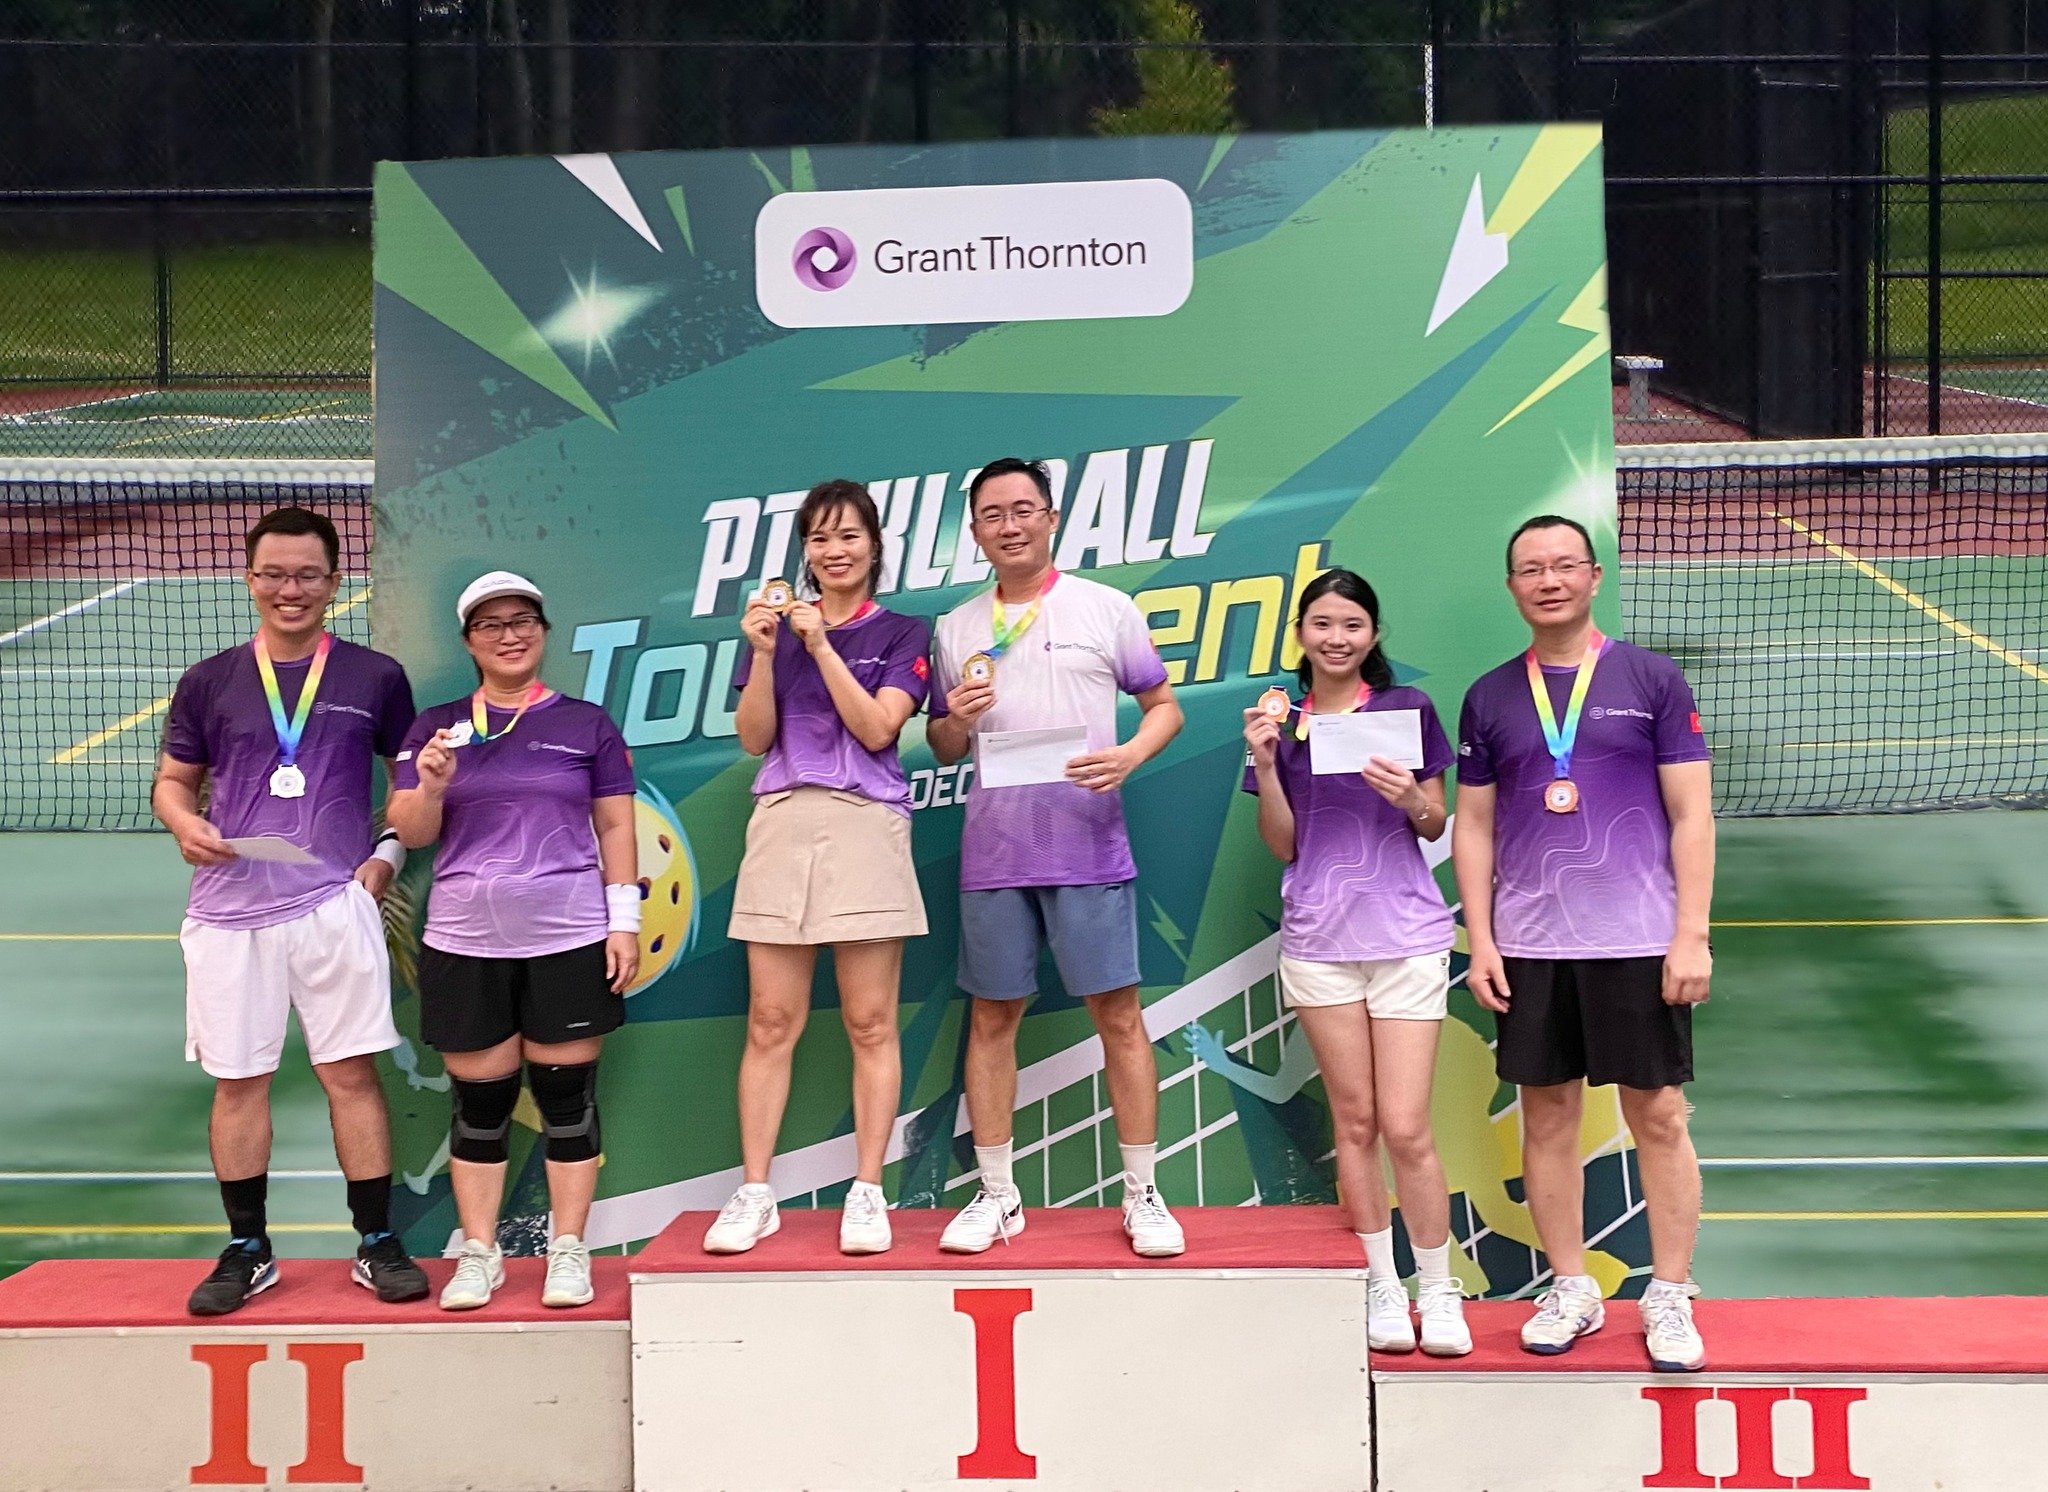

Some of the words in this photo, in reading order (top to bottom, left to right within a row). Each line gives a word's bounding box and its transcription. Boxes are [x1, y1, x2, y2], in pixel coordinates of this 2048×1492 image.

[874, 239, 977, 274] Grant
[979, 235, 1147, 270] Thornton
[190, 1342, 364, 1485] II
[953, 1287, 1037, 1480] I
[1641, 1387, 1871, 1489] III
